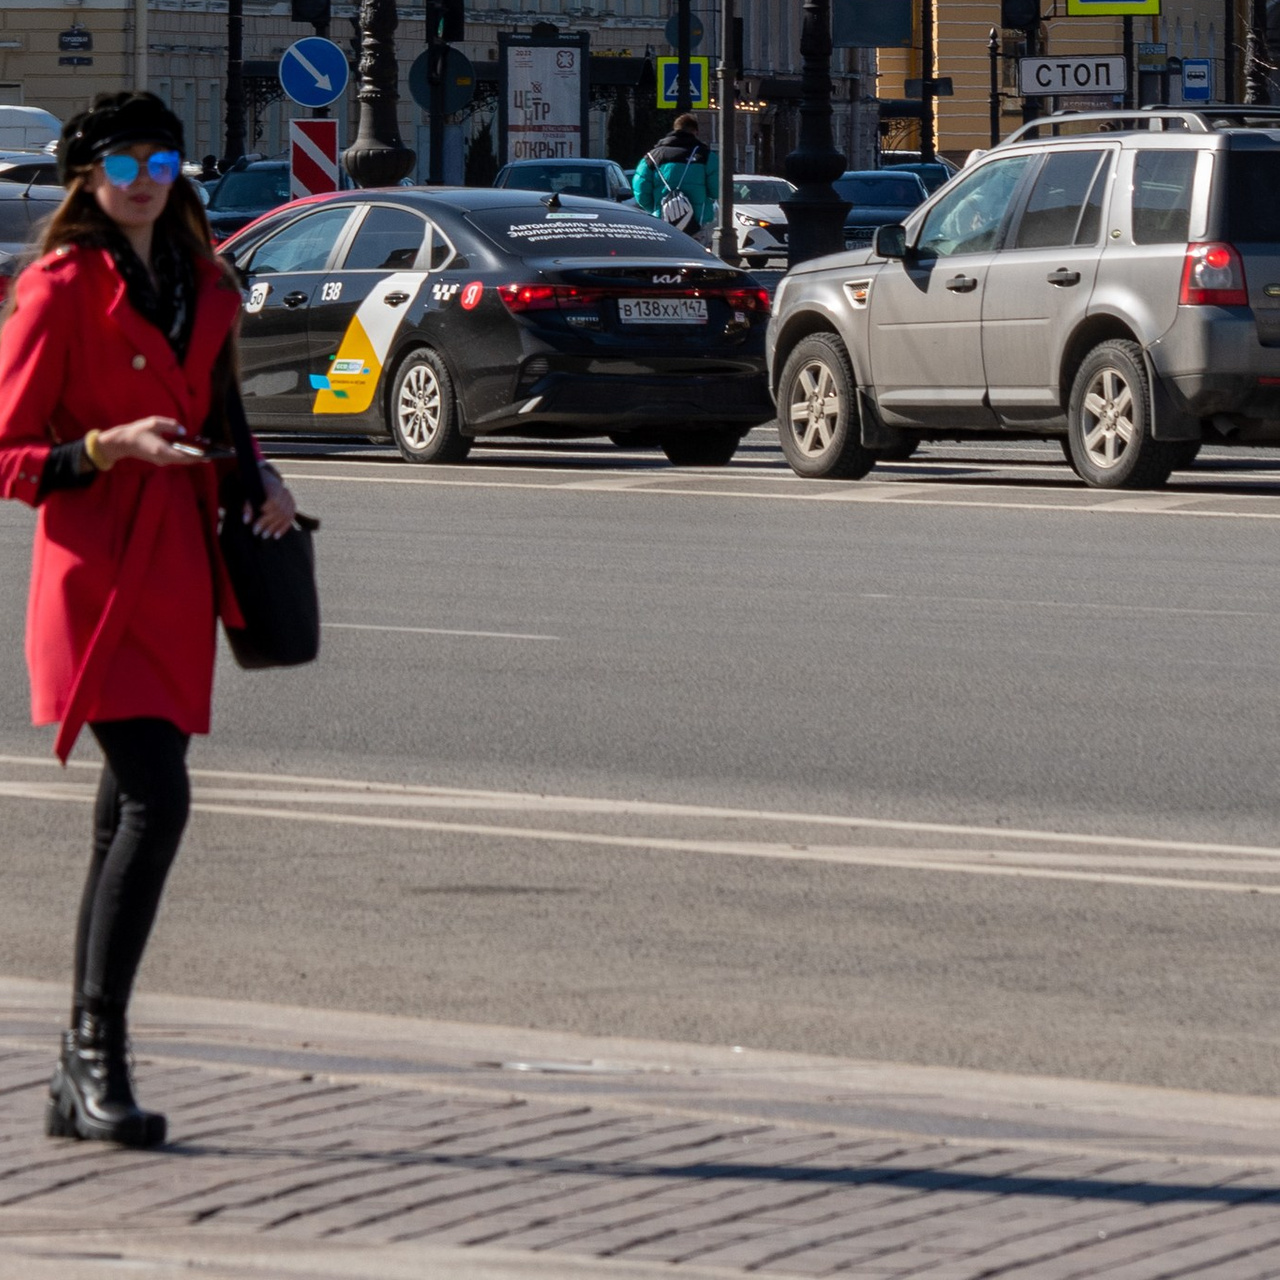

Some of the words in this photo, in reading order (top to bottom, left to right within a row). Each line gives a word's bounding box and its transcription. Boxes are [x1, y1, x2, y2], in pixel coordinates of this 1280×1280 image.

[1035, 62, 1111, 87] СТОП
[510, 222, 587, 231] Автомобиль
[652, 274, 682, 284] KIA
[321, 282, 343, 301] 138
[465, 285, 479, 305] Я
[624, 301, 679, 317] В138ХХ
[682, 301, 702, 314] 147
